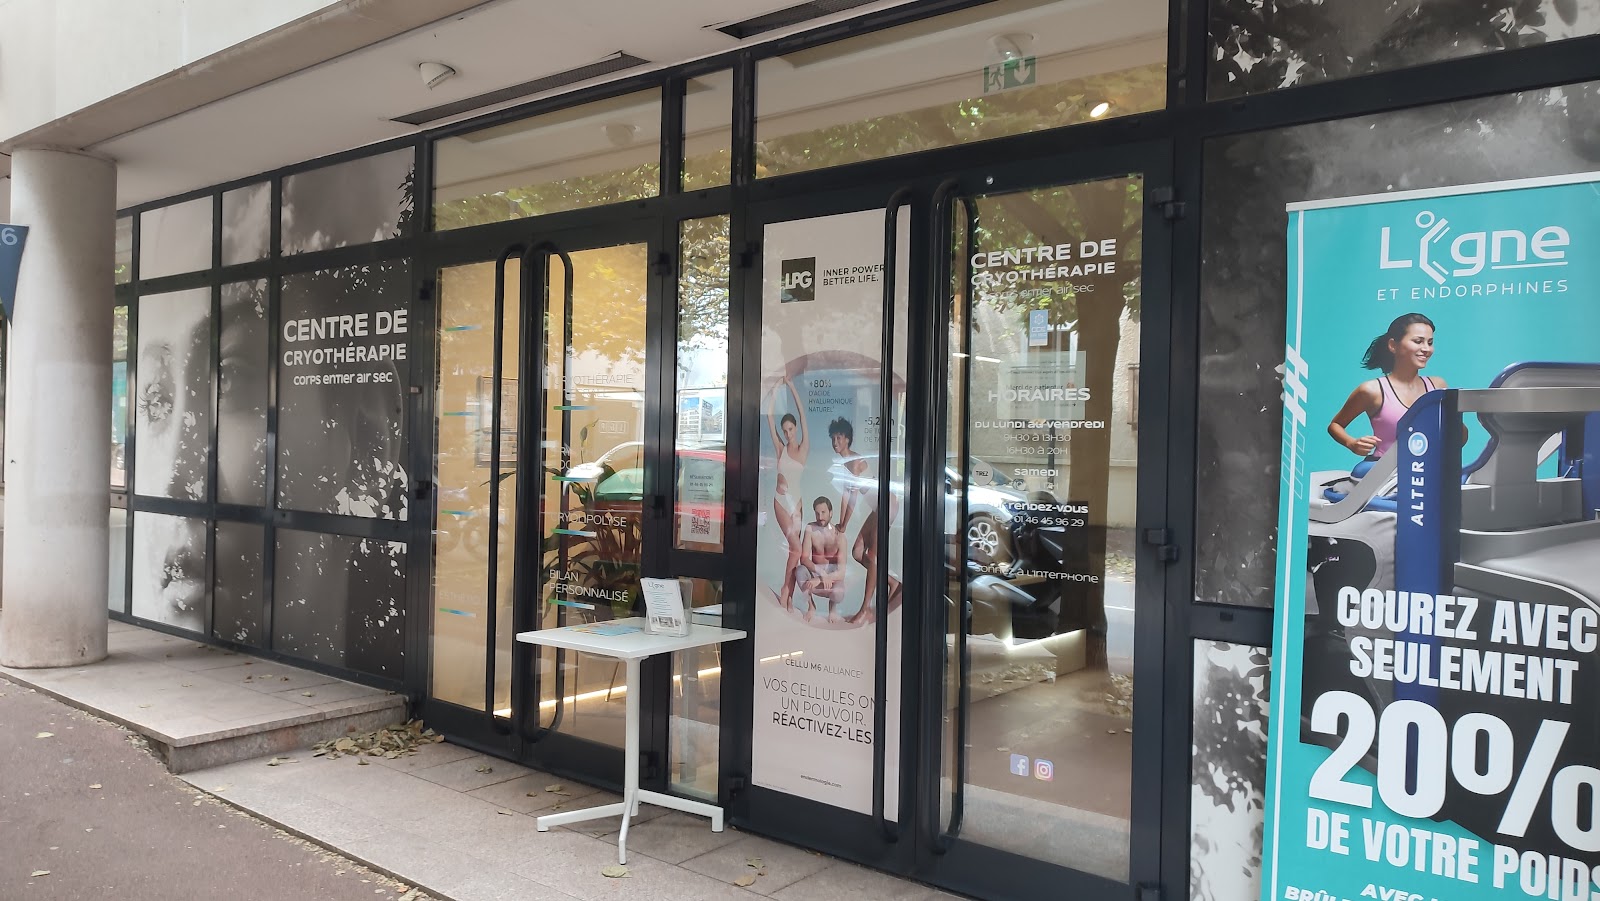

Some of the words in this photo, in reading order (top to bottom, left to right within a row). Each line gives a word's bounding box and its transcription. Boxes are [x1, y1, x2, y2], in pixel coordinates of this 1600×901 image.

[971, 243, 1071, 269] CENTRE
[1080, 238, 1117, 258] DE
[1380, 211, 1569, 285] Ligne
[785, 270, 813, 290] LPG
[823, 267, 849, 277] INNER
[823, 276, 856, 286] BETTER
[858, 274, 879, 283] LIFE.
[970, 261, 1116, 287] CRYOTHÉRAPIE
[1072, 284, 1094, 294] sec
[1377, 288, 1399, 301] ET
[1411, 279, 1568, 300] ENDORPHINES
[283, 313, 369, 343] CENTRE
[375, 309, 409, 335] DE
[283, 340, 407, 367] CRYOTHÉRAPIE
[373, 371, 393, 383] sec
[554, 373, 633, 386] COTHÉRAPIE
[988, 387, 1091, 402] HORAIRES
[1004, 434, 1030, 442] 9H30
[1042, 434, 1071, 442] 13H30
[1006, 446, 1035, 455] 16H30
[1037, 445, 1045, 455] à
[1047, 447, 1068, 455] 20H
[1410, 462, 1424, 526] ALTER
[1014, 515, 1023, 523] 01
[1025, 516, 1039, 524] 46
[1040, 517, 1054, 525] 45
[1055, 517, 1069, 526] 96
[1070, 519, 1085, 527] 29
[549, 569, 579, 582] BILAN
[549, 582, 629, 603] PERSONNALISÉ
[1336, 585, 1479, 641] COUREZ
[1491, 600, 1598, 653] AVEC
[785, 658, 809, 669] CELLU
[810, 663, 822, 672] M6
[1350, 636, 1579, 704] SEULEMENT
[763, 677, 788, 692] VOS
[790, 682, 855, 707] CELLULES
[781, 696, 799, 712] UN
[803, 701, 867, 727] POUVOIR.
[1309, 690, 1600, 852] 20%
[1306, 807, 1350, 856] DE
[1362, 817, 1479, 884] VOTRE
